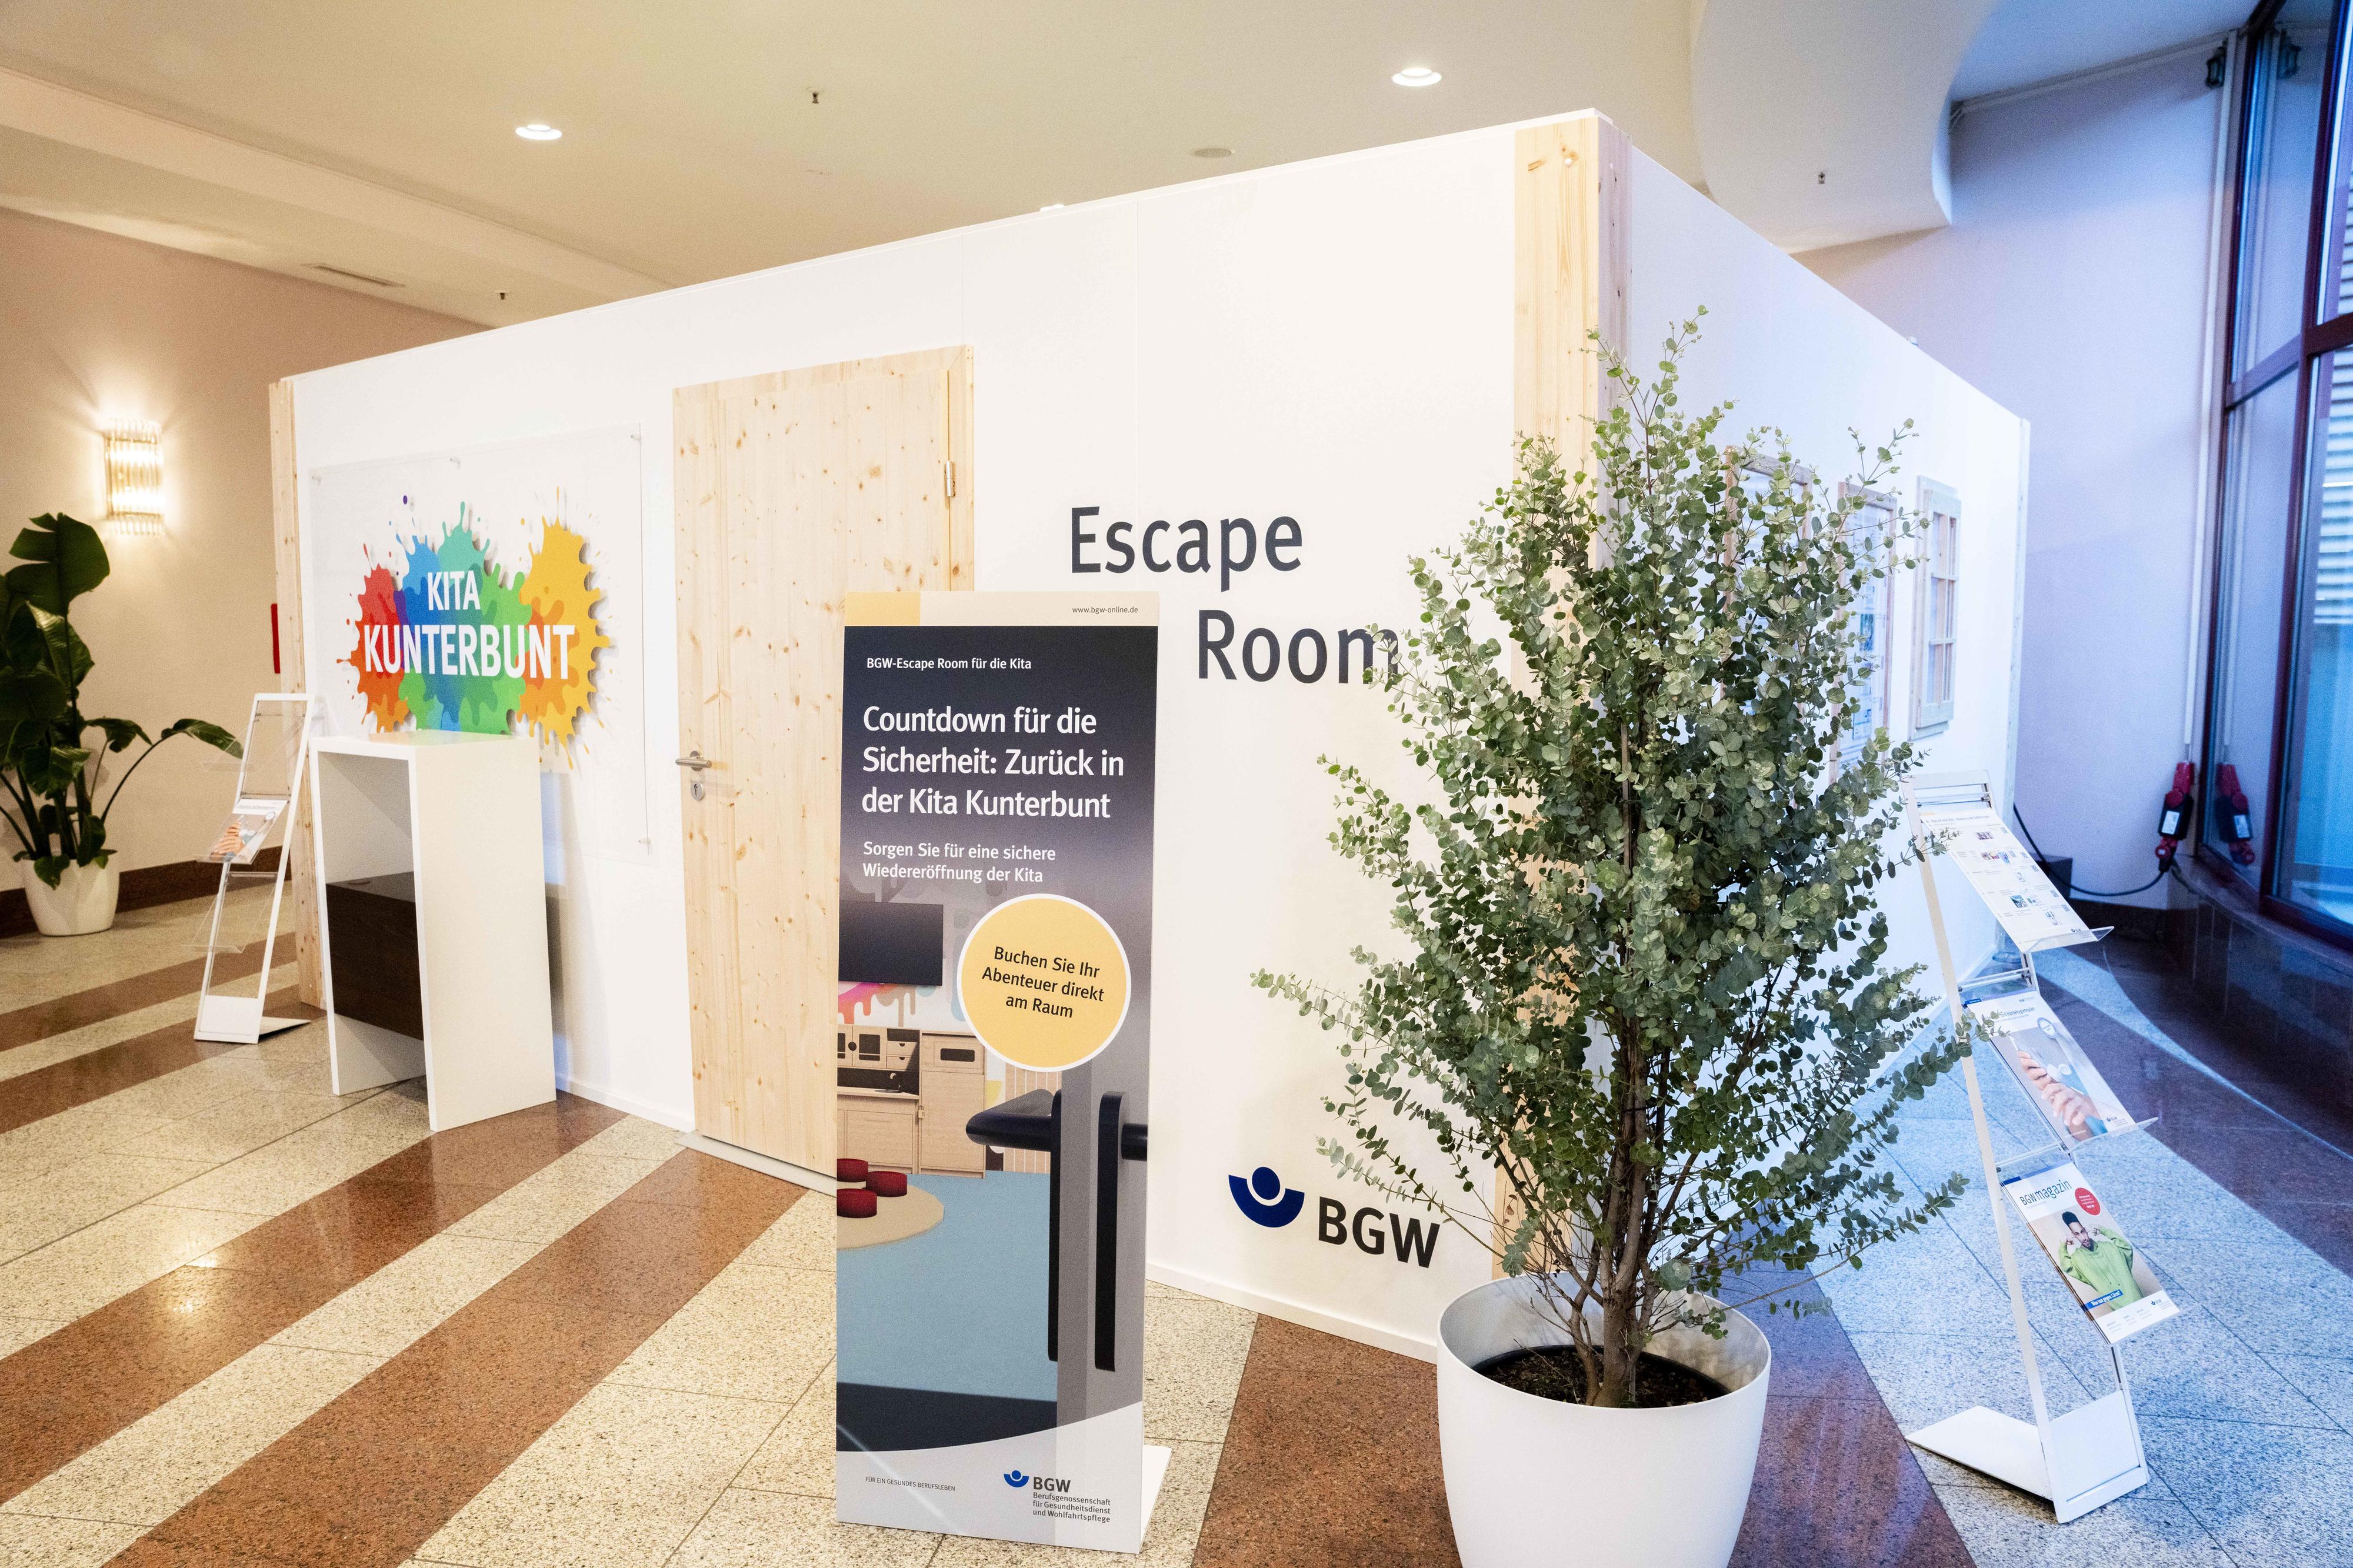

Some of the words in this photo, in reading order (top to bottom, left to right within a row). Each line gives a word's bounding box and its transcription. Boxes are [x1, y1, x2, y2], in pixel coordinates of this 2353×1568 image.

[1072, 506, 1302, 592] Escape
[428, 570, 481, 610] KITA
[364, 625, 575, 679] KUNTERBUNT
[1199, 609, 1399, 685] Room
[867, 658, 934, 670] BGW-Escape
[938, 658, 968, 668] Room
[972, 658, 987, 669] für
[990, 658, 1006, 669] die
[1010, 658, 1031, 669] Kita
[864, 706, 1005, 732] Countdown
[1014, 706, 1051, 733] für
[1057, 707, 1096, 733] die
[863, 746, 996, 773] Sicherheit:
[1005, 749, 1094, 775] Zurück
[1102, 749, 1123, 776] in
[862, 786, 903, 813] der
[910, 788, 958, 814] Kita
[966, 790, 1110, 818] Kunterbunt
[864, 842, 912, 859] Sorgen
[918, 843, 939, 857] Sie
[944, 843, 964, 858] für
[968, 844, 998, 859] eine
[1004, 845, 1055, 860] sichere
[863, 863, 982, 883] Wiedereröffnung
[987, 866, 1011, 880] der
[1015, 868, 1042, 882] Kita
[995, 946, 1047, 968] Buchen
[1052, 958, 1075, 973] Sie
[1080, 962, 1099, 978] Ihr
[982, 967, 1058, 993] Abenteuer
[1062, 982, 1104, 1001] direkt
[1006, 996, 1027, 1009] am
[1033, 998, 1072, 1017] Raum
[1318, 1196, 1440, 1269] BGW
[886, 1479, 916, 1487] GESUNDES
[918, 1482, 955, 1491] BERUFSLEBEN
[1033, 1492, 1111, 1505] Berufsgenossenschaft
[1034, 1477, 1071, 1493] BGW
[1044, 1501, 1111, 1514] Gesundheitsdienst
[1047, 1510, 1111, 1524] Wohlfahrtspflege
